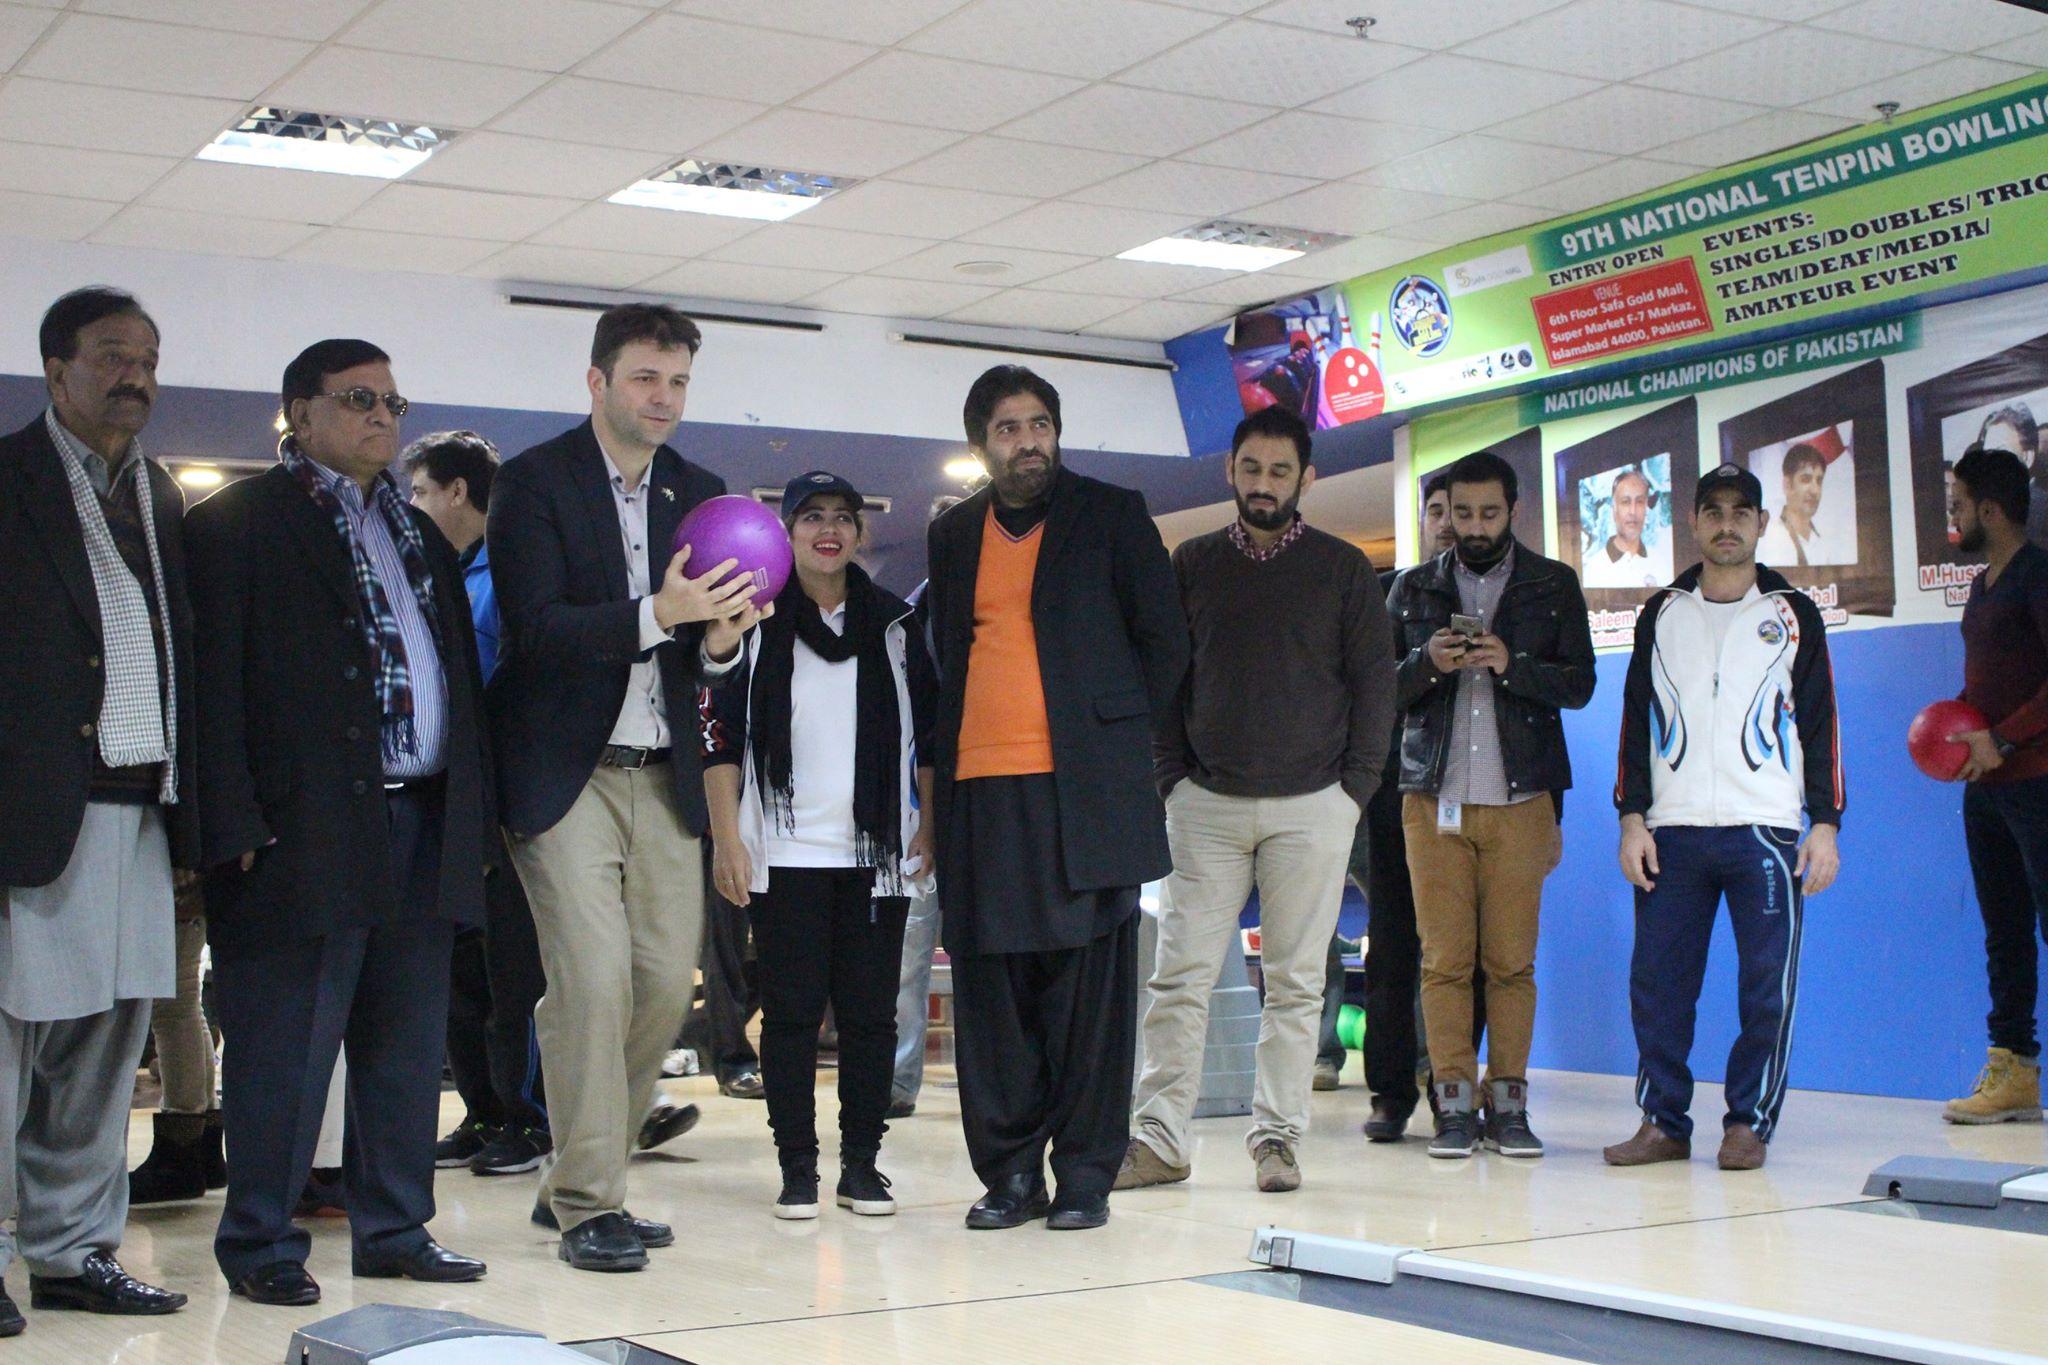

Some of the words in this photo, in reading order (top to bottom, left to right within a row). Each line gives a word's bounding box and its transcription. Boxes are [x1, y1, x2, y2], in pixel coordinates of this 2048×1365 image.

[1561, 222, 1616, 257] 9TH
[1620, 181, 1769, 241] NATIONAL
[1772, 142, 1895, 197] TENPIN
[1901, 94, 2048, 162] BOWLIN
[1702, 211, 1815, 253] EVENTS:
[1548, 260, 1607, 287] ENTRY
[1612, 245, 1665, 269] OPEN
[1549, 313, 1568, 326] 6th
[1570, 305, 1599, 321] Floor
[1600, 299, 1625, 313] Safa
[1627, 290, 1655, 307] Gold
[1657, 282, 1688, 299] Mall,
[1725, 280, 1857, 324] AMATEUR
[1861, 254, 1959, 292] EVENT
[1551, 326, 1583, 343] Super
[1585, 318, 1626, 335] Market
[1627, 310, 1646, 325] F-7
[1649, 301, 1697, 319] Markaz,
[1552, 339, 1609, 361] Islamabad
[1611, 330, 1650, 347] 44000,
[1652, 318, 1706, 337] Pakistan.
[1545, 380, 1635, 414] NATIONAL
[1639, 353, 1757, 394] CHAMPIONS
[1762, 345, 1789, 370] OF
[1796, 321, 1904, 364] PAKISTAN
